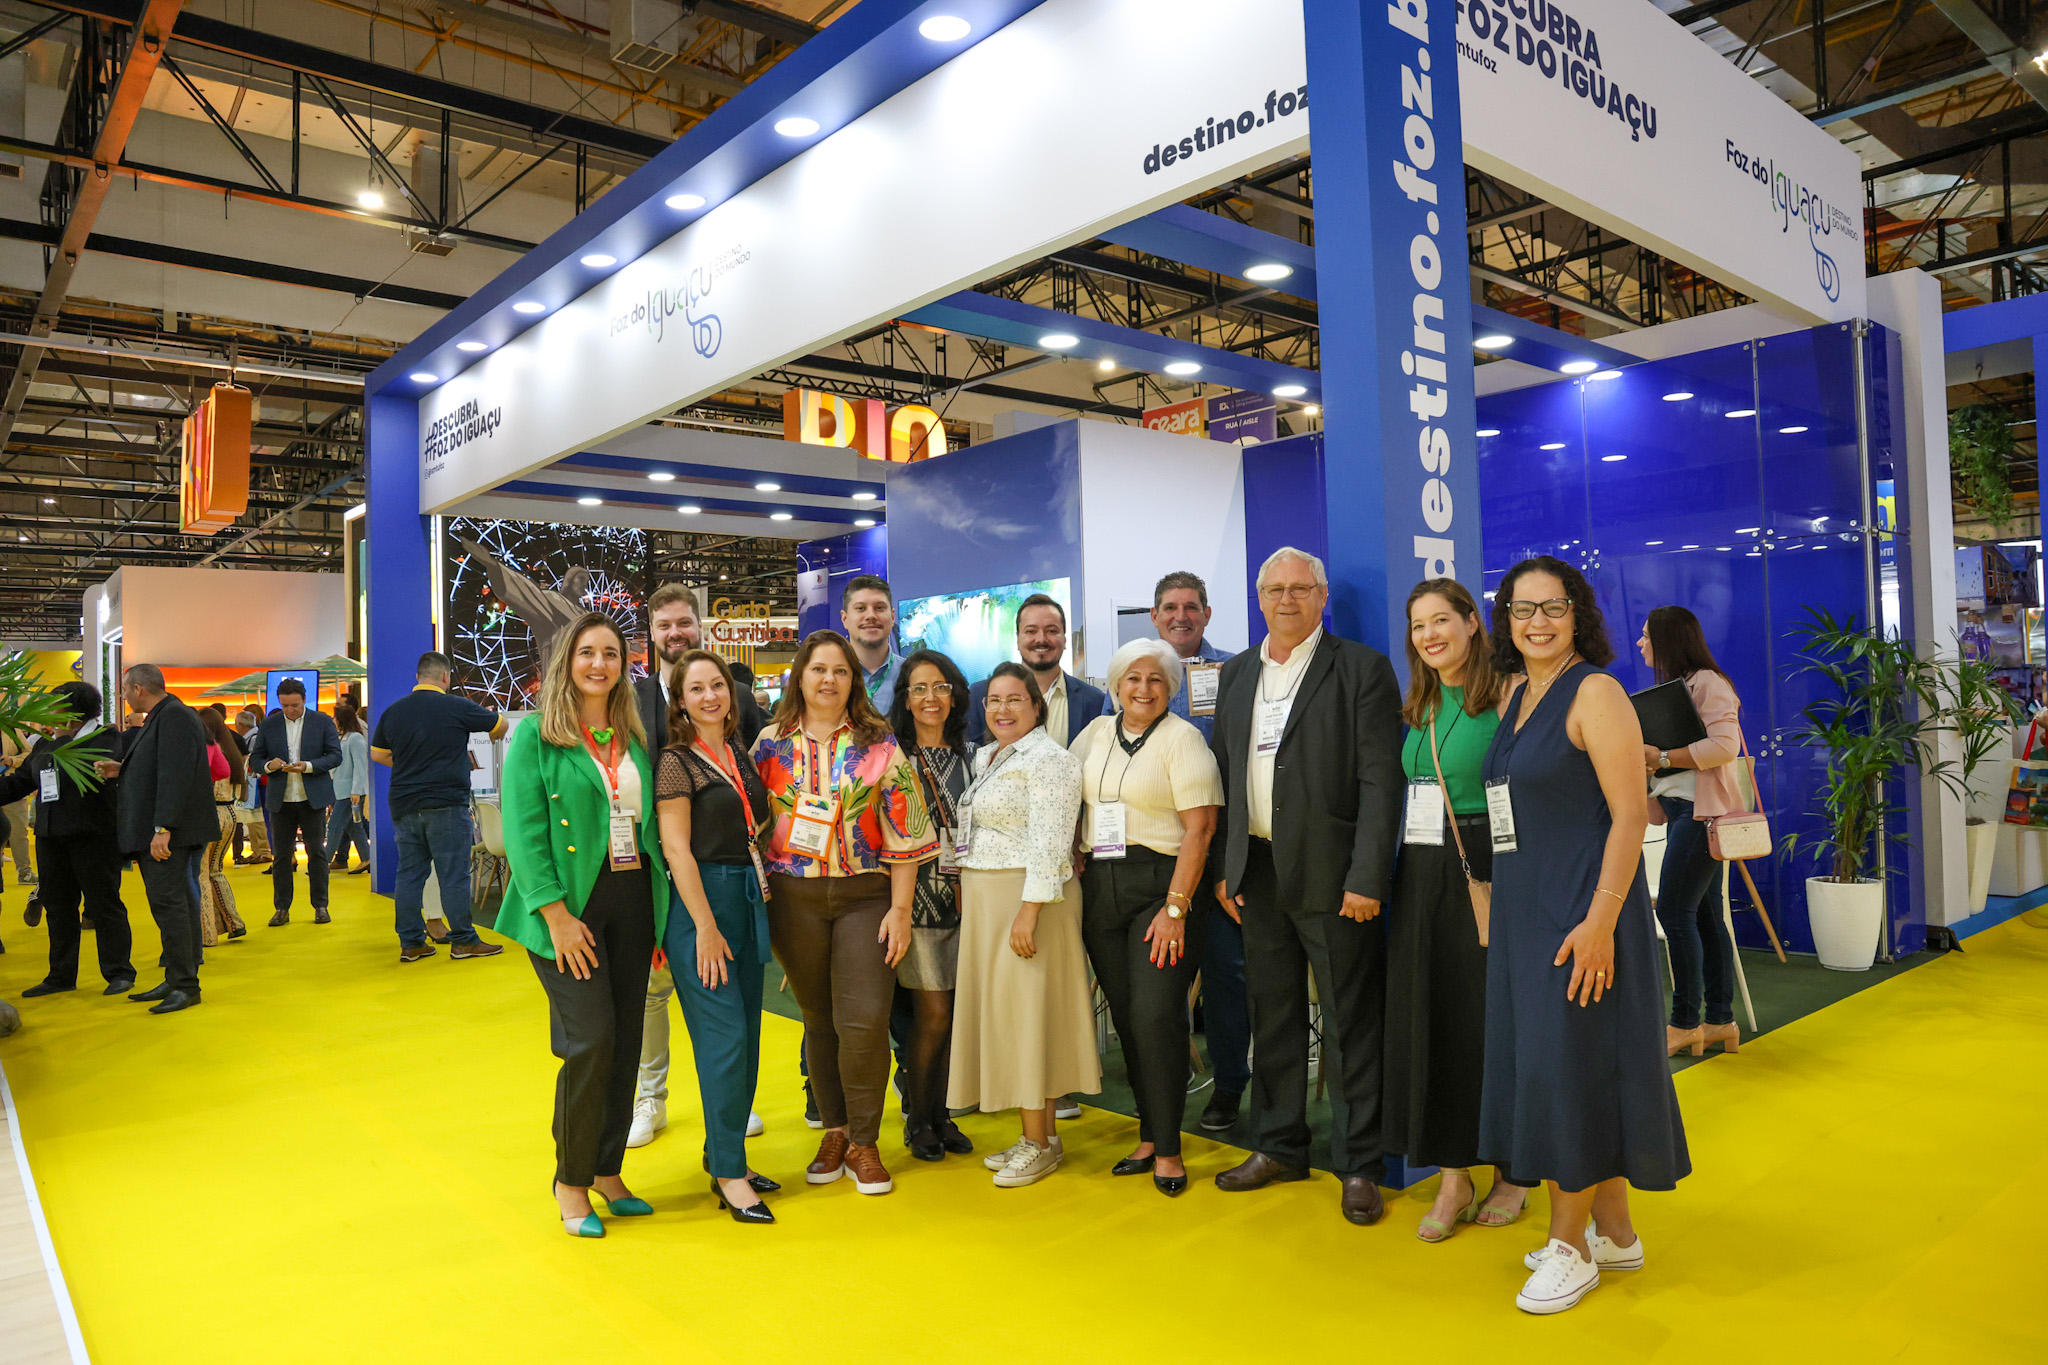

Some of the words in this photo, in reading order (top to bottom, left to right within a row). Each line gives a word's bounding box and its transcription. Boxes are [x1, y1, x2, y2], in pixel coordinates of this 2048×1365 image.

[1496, 0, 1602, 70] CUBRA
[1515, 22, 1557, 79] DO
[1562, 52, 1657, 142] IGUAÇU
[1143, 84, 1309, 175] destino.foz
[1726, 138, 1749, 174] Foz
[1752, 157, 1768, 185] do
[1770, 159, 1831, 252] Iguaçu
[1832, 206, 1852, 226] DESTINO
[1832, 218, 1840, 230] DO
[1840, 222, 1859, 241] MUNDO
[725, 251, 751, 272] MUNDO
[610, 314, 629, 337] Foz
[631, 303, 645, 325] do
[432, 436, 448, 460] FOZ
[450, 428, 463, 452] DO
[464, 406, 501, 444] IGUAÇU
[1225, 421, 1238, 430] RUA
[1243, 416, 1259, 426] AISLE
[712, 597, 770, 619] Curta
[711, 620, 793, 643] Curitiba
